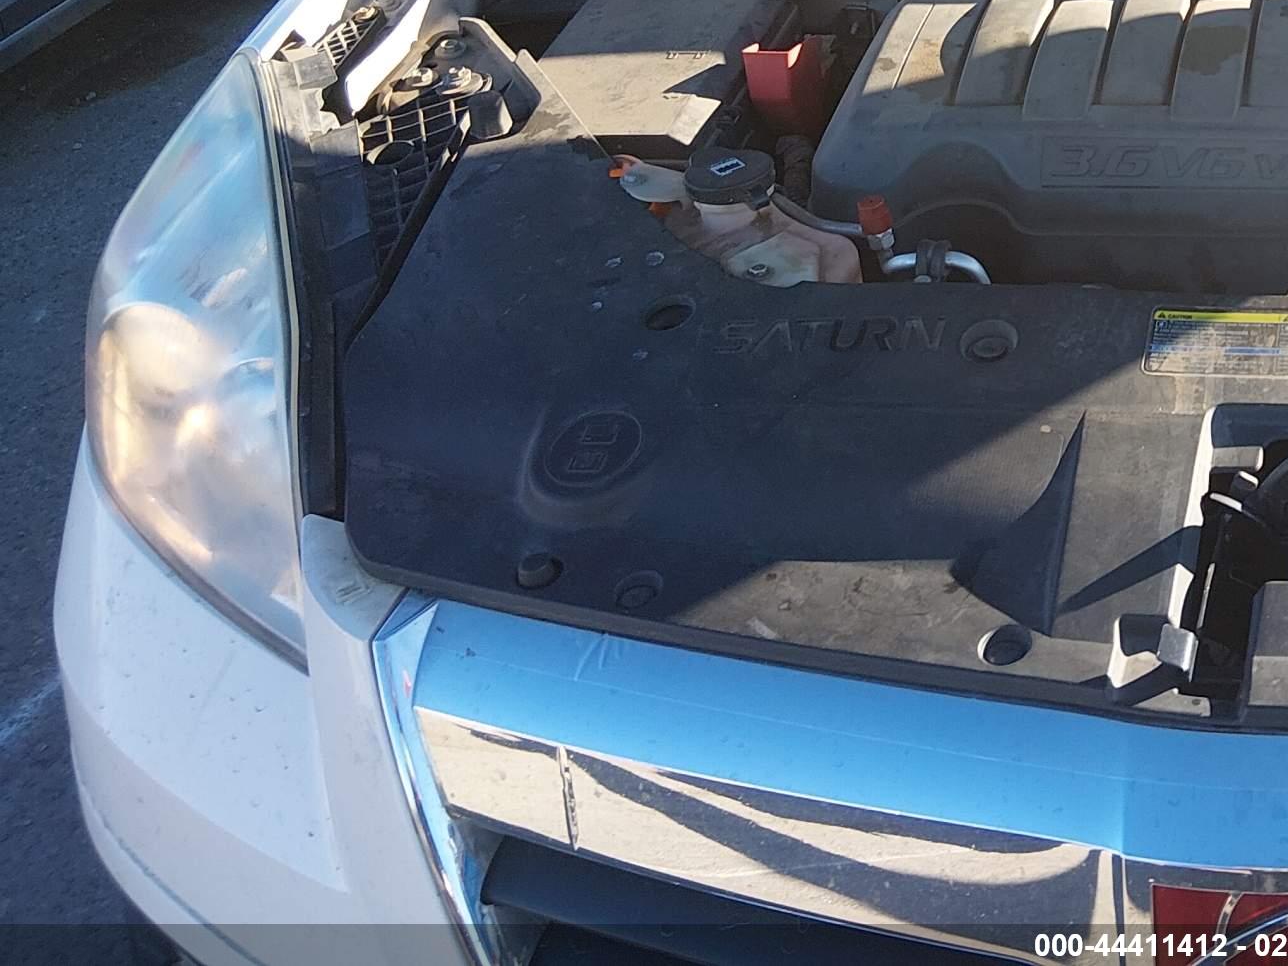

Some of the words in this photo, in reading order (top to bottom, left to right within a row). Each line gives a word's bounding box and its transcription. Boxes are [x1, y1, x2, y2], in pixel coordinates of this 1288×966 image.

[1051, 145, 1154, 178] 3.6
[1160, 145, 1247, 179] V6
[712, 315, 948, 354] SATURN
